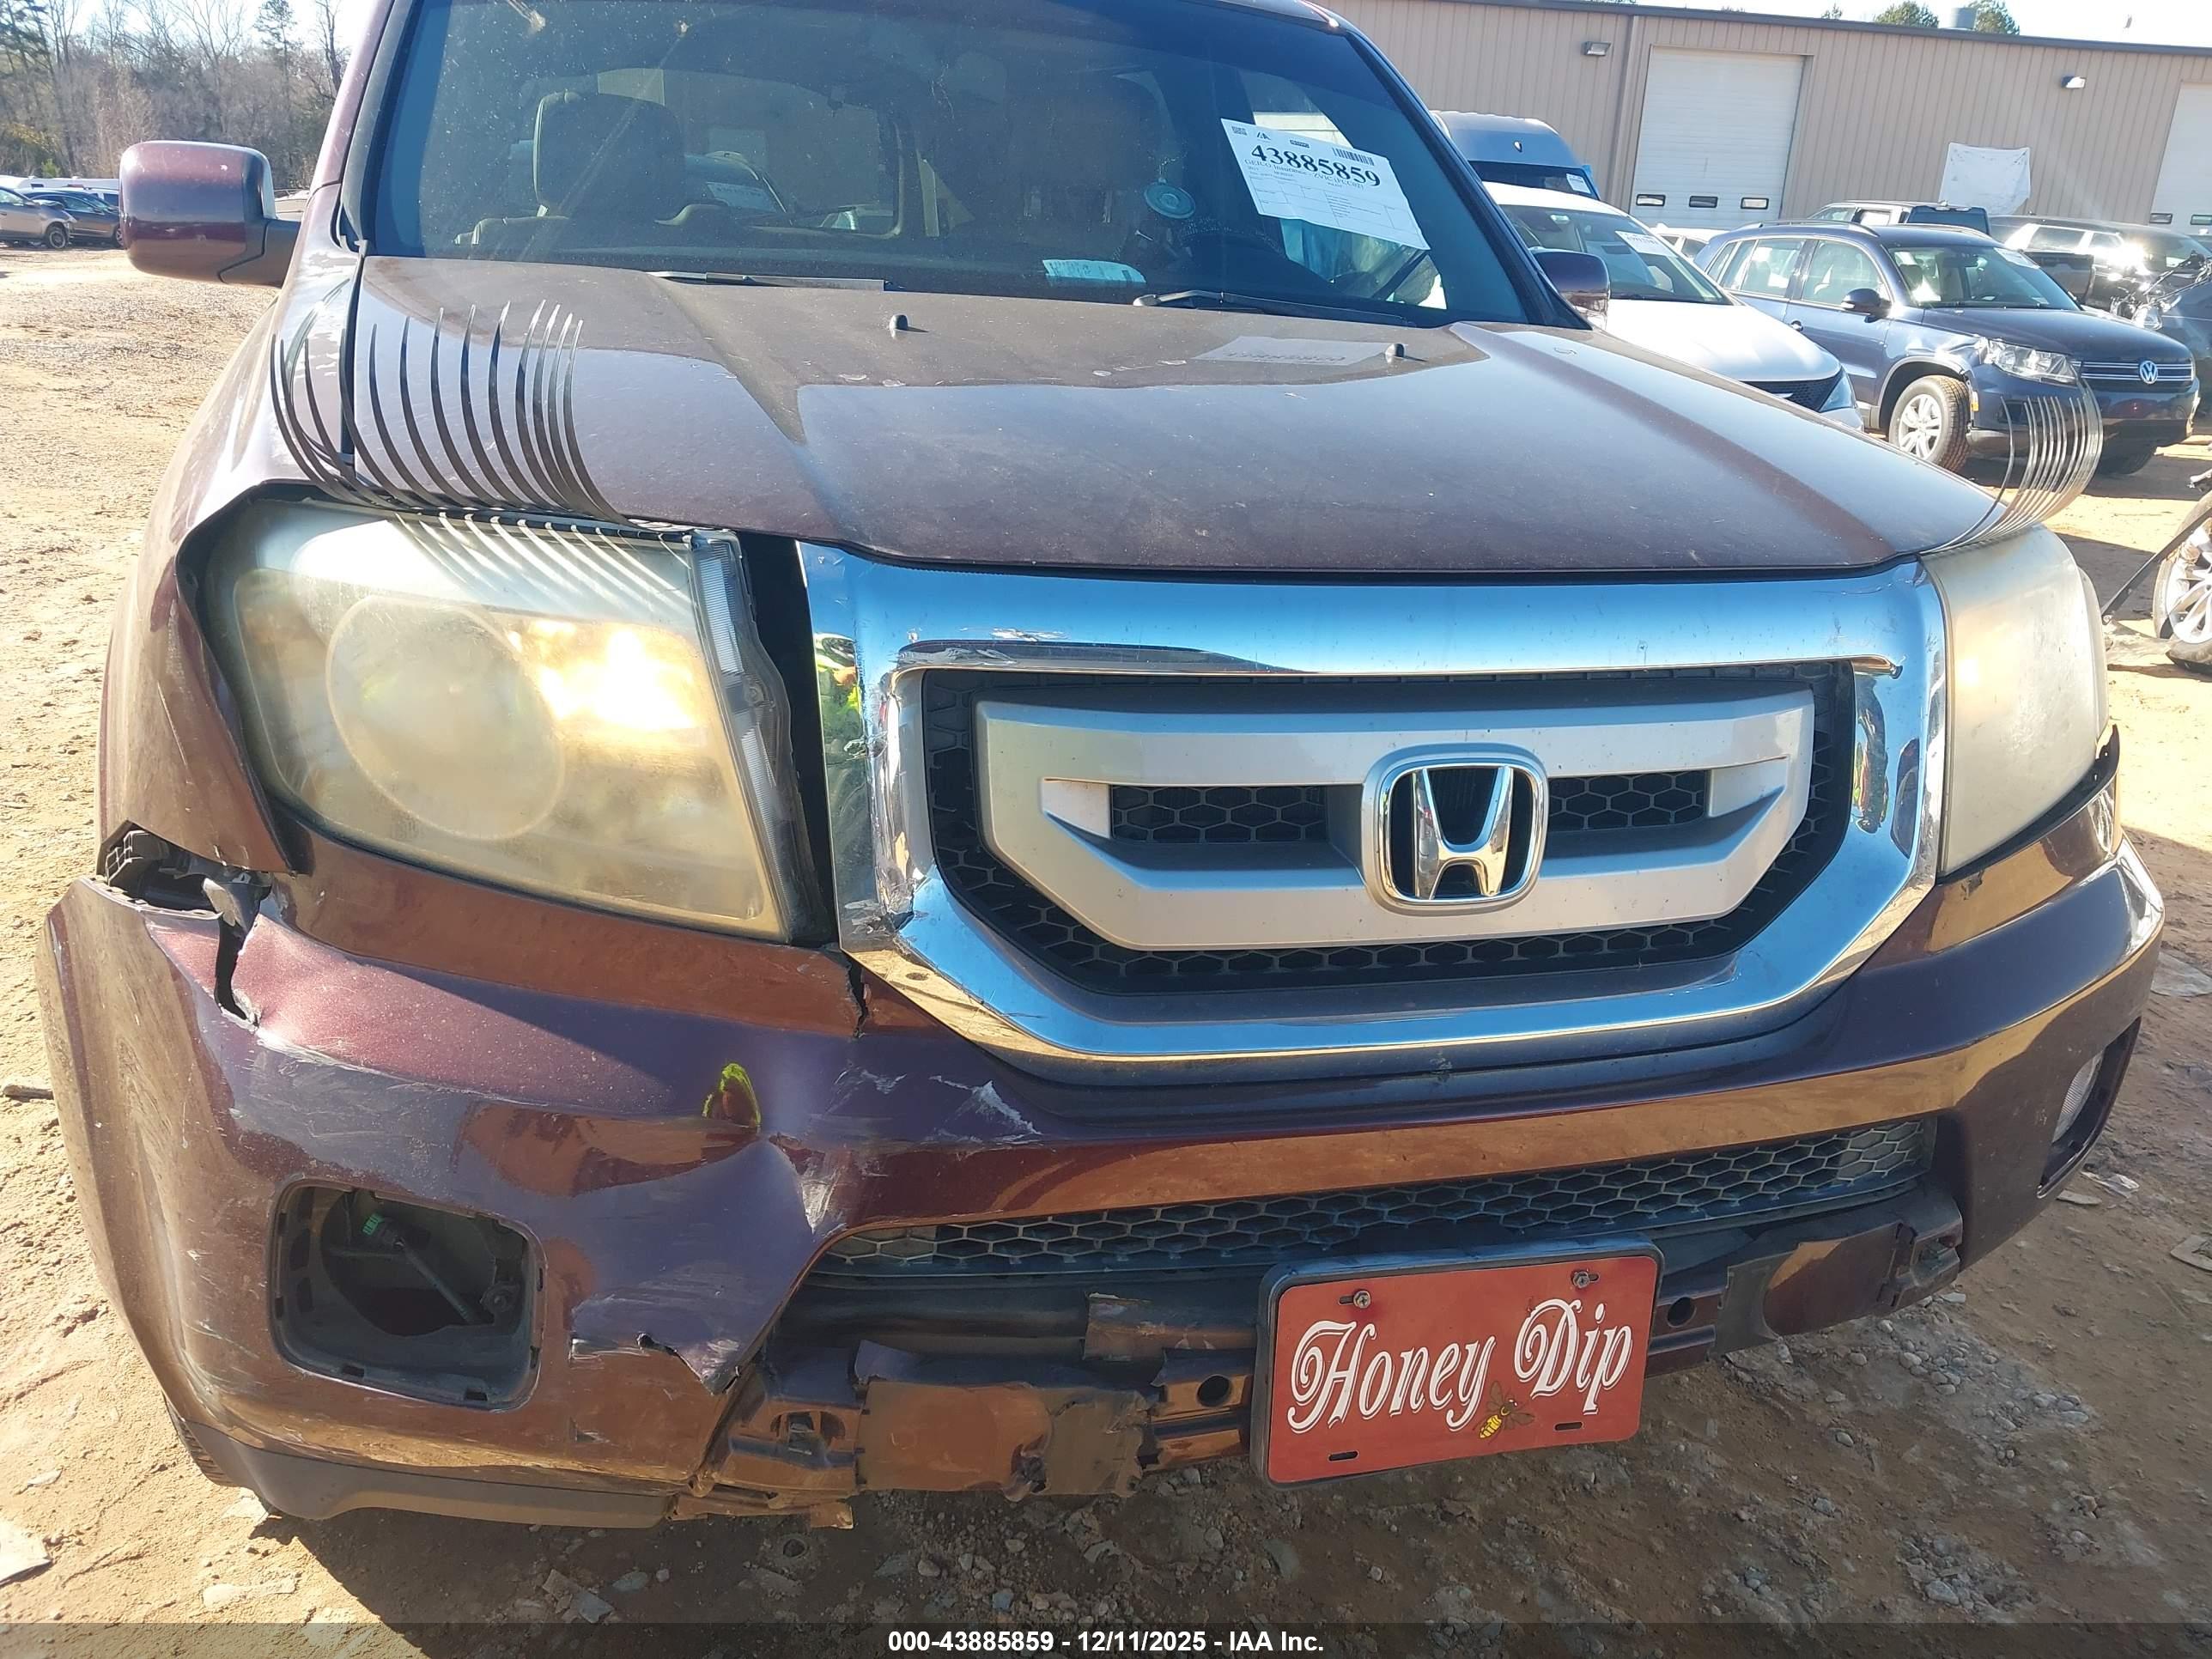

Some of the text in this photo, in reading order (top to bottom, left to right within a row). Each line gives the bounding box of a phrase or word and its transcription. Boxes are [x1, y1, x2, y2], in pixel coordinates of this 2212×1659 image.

[1251, 144, 1381, 186] 43885859
[1287, 1298, 1632, 1434] Honey Dip
